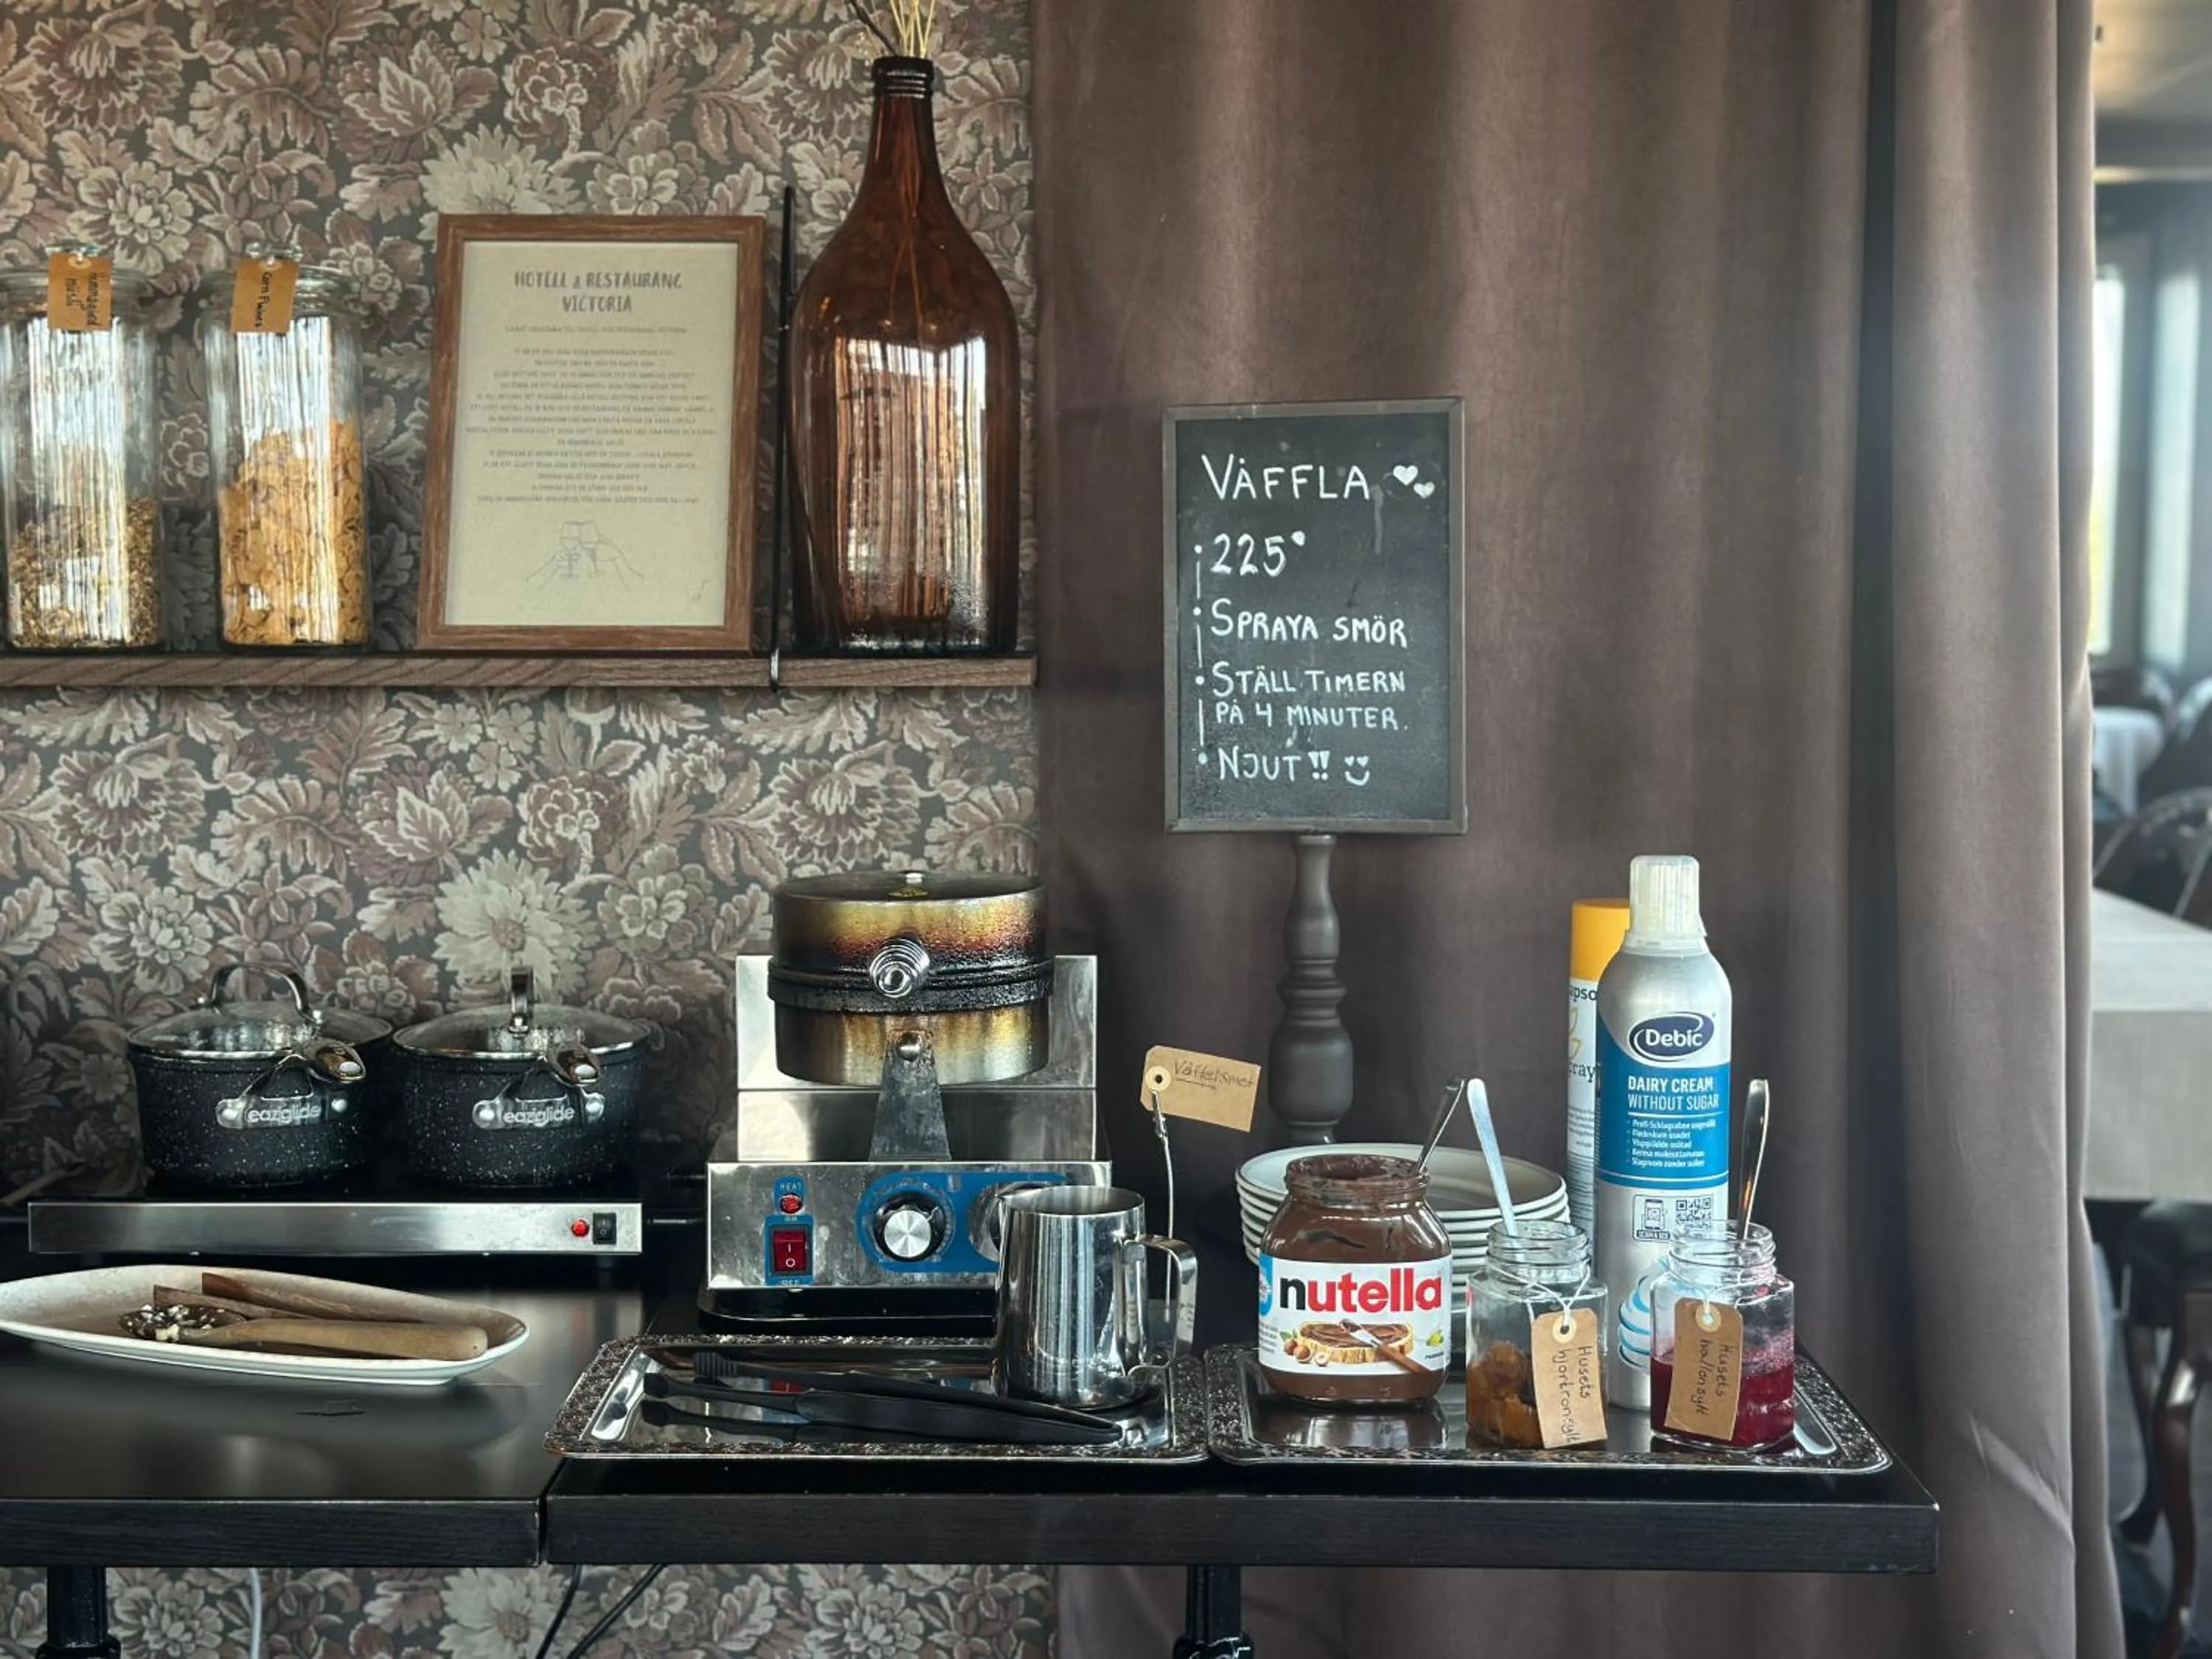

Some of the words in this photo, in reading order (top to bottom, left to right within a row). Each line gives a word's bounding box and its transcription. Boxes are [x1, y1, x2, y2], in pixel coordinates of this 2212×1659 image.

[514, 271, 567, 289] HOTELL
[561, 293, 633, 313] VICTORIA
[1332, 613, 1408, 649] SMÖR
[1211, 661, 1297, 698] STÄLL
[1256, 702, 1273, 728] 4
[1645, 1028, 1703, 1048] Debic
[1627, 1075, 1669, 1093] DAIRY
[1671, 1077, 1714, 1093] CREAM
[1627, 1093, 1683, 1110] WITHOUT
[1686, 1093, 1720, 1110] SUGAR
[779, 1182, 801, 1192] HEAT
[1279, 1267, 1442, 1313] nutella
[1578, 1346, 1593, 1399] Husets
[1716, 1344, 1736, 1398] Husets
